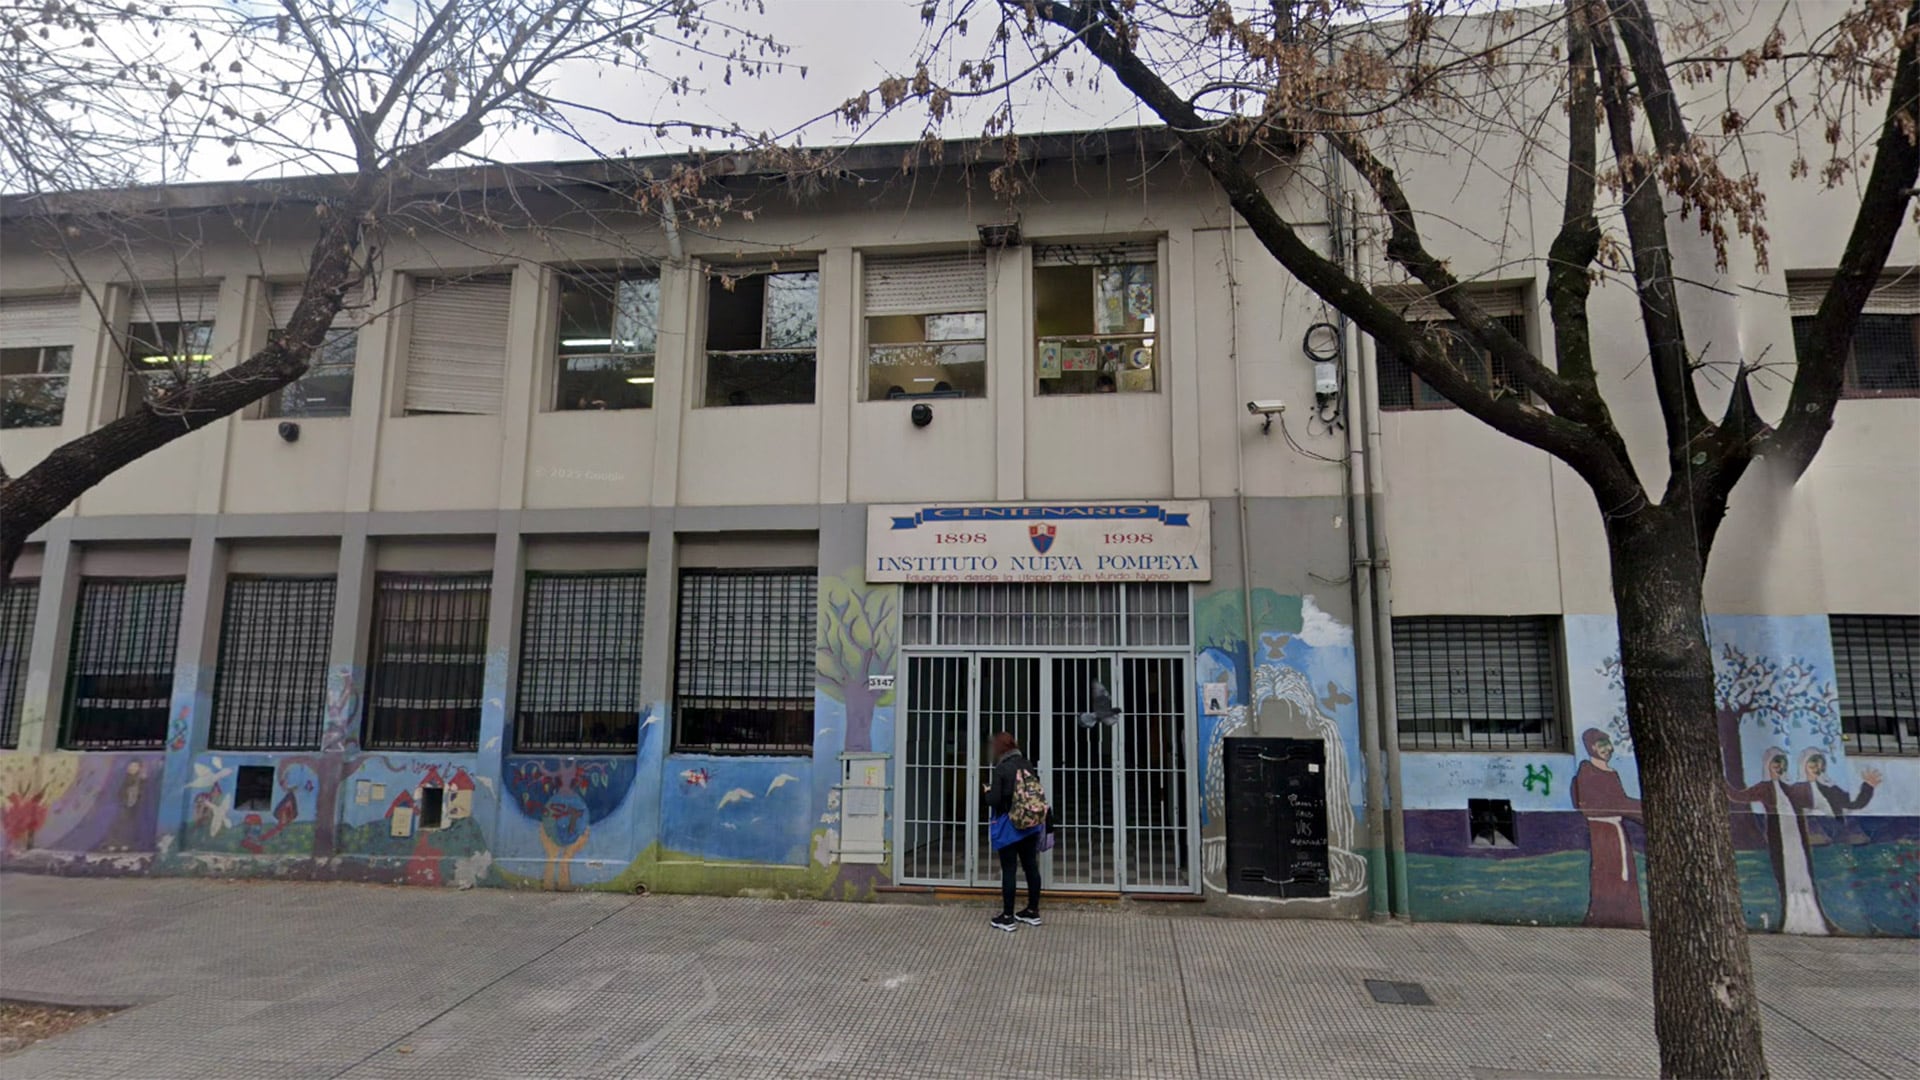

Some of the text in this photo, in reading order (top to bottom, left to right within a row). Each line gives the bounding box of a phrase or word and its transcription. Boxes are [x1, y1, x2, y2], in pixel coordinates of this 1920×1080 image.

[933, 506, 1148, 518] CENTENARIO
[936, 533, 1154, 545] 1898 1998
[878, 554, 1201, 571] INSTITUTO NUEVA POMPEYA
[964, 572, 999, 582] desde
[1003, 573, 1014, 582] la
[1057, 573, 1072, 581] de
[1078, 573, 1091, 581] un
[1095, 572, 1130, 581] Mundo
[869, 677, 895, 688] 3147
